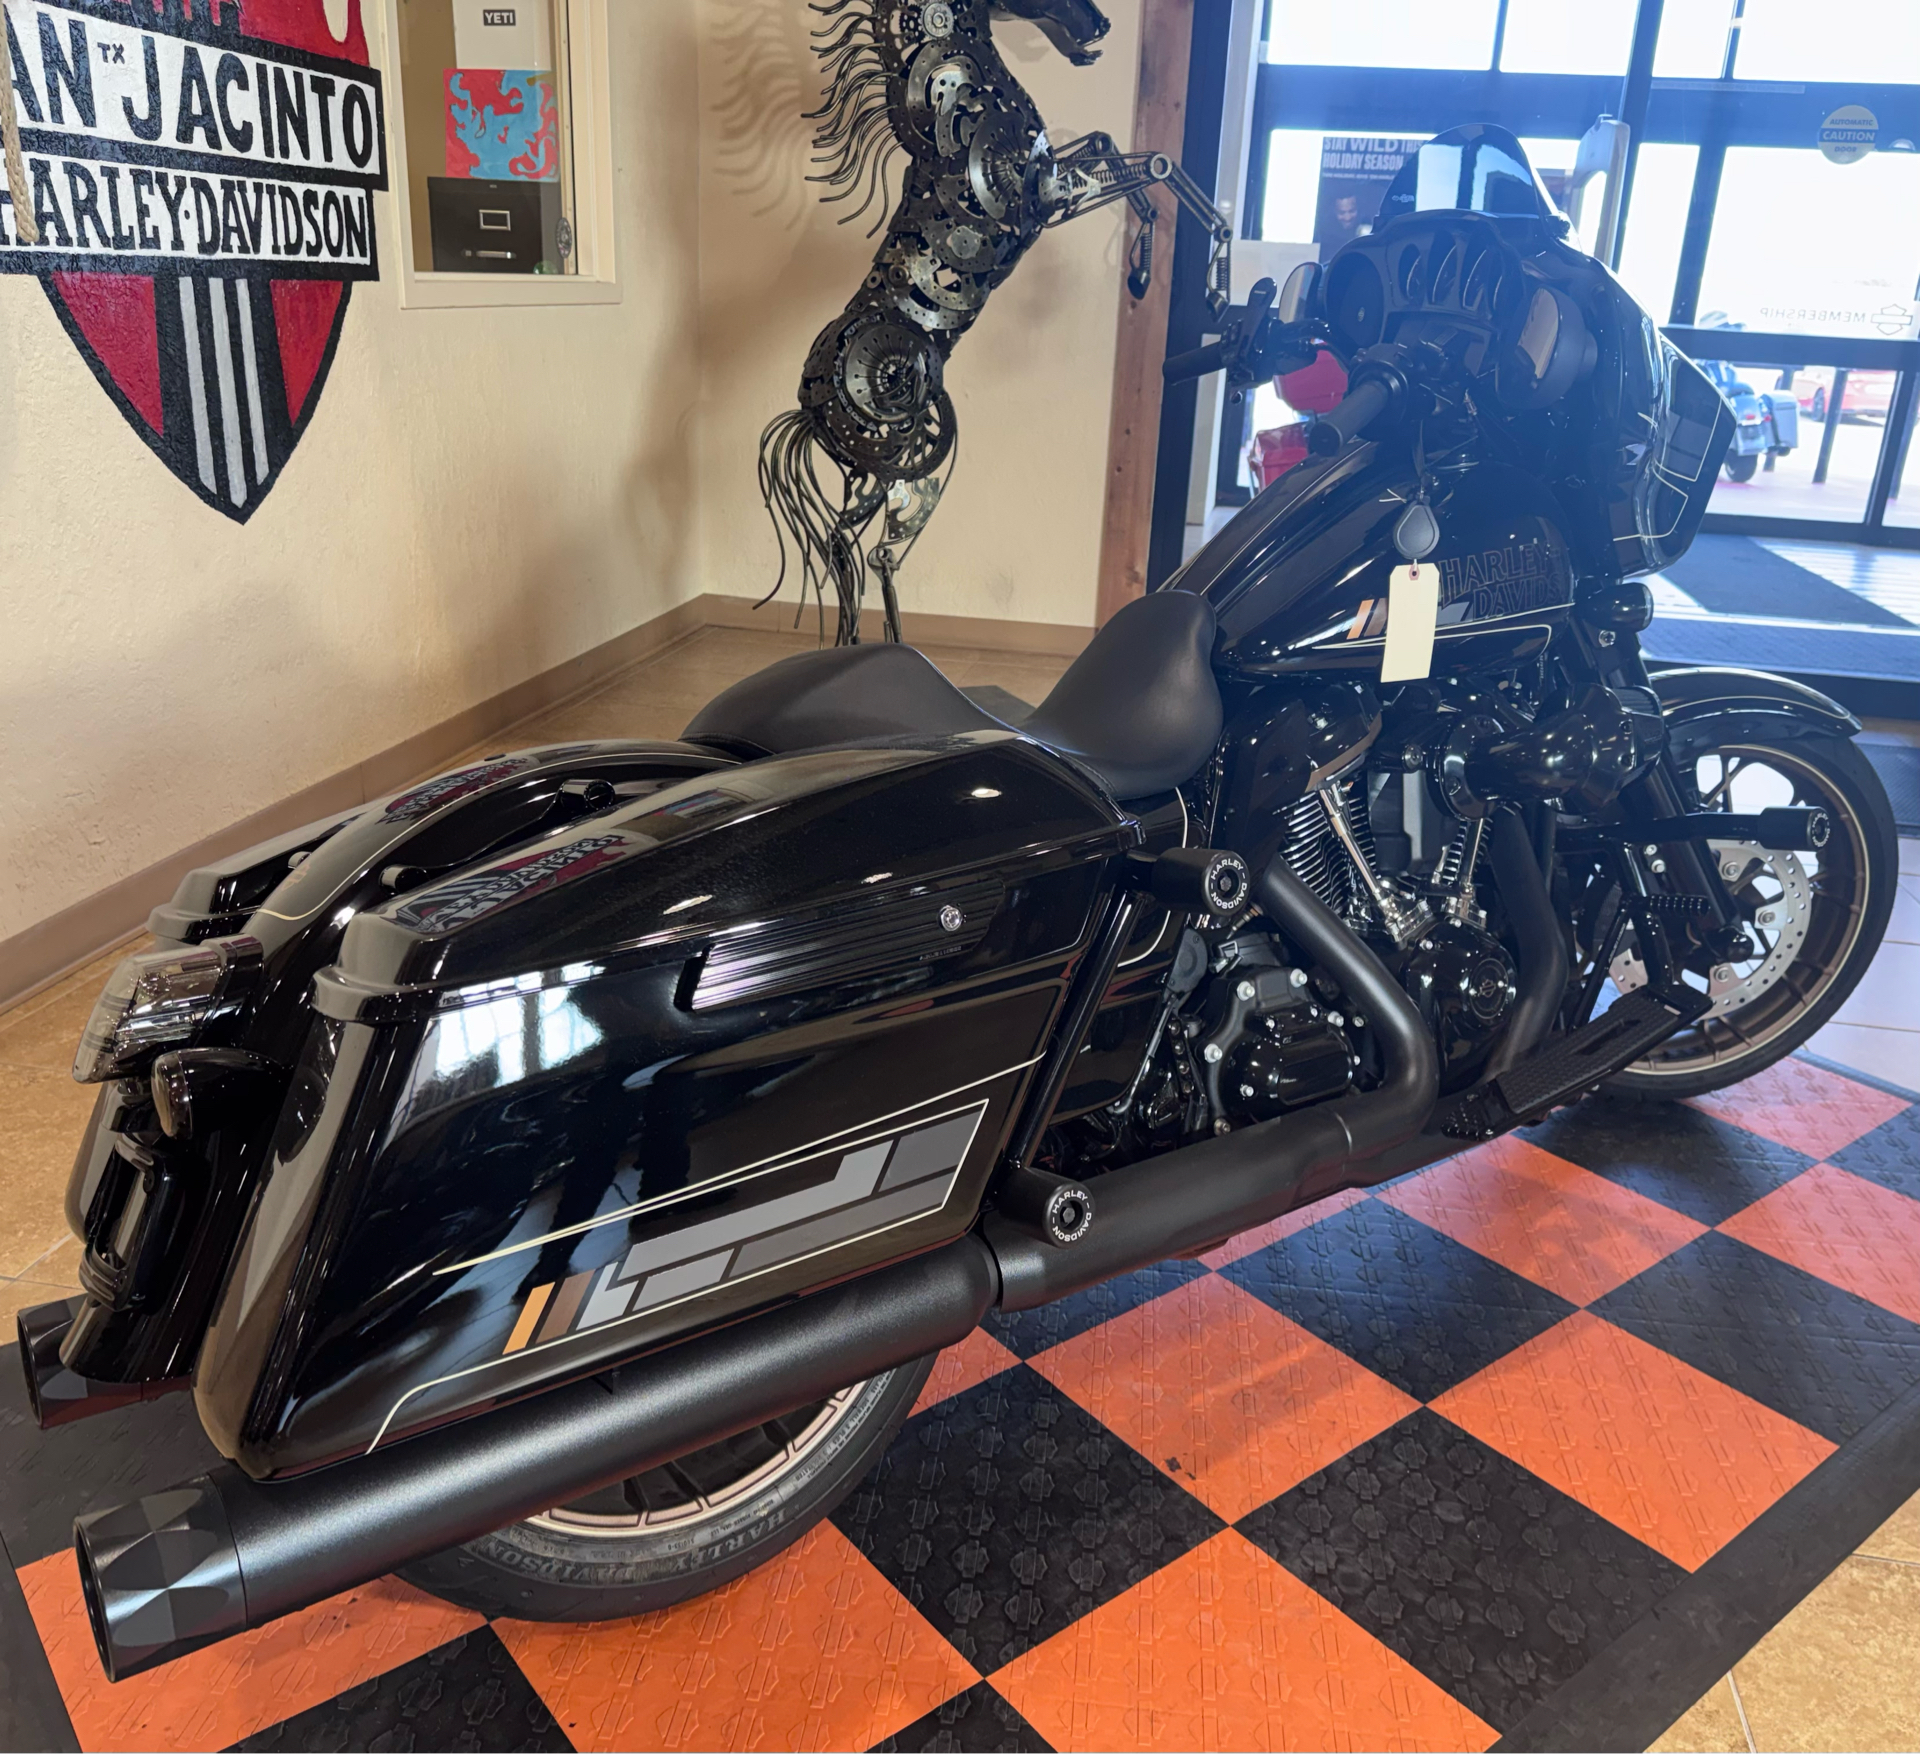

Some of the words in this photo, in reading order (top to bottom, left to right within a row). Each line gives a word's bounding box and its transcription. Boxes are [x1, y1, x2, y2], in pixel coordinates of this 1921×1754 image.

[484, 11, 514, 24] YETI
[98, 42, 125, 64] TX
[122, 36, 374, 168] JACINTO
[1829, 118, 1874, 126] AUTOMATIC
[1349, 137, 1399, 153] WILD
[1822, 131, 1876, 141] CAUTION
[1322, 152, 1364, 169] HOLIDAY
[1364, 154, 1404, 171] SEASON
[1211, 858, 1243, 880] HARLEY
[1211, 882, 1248, 909] DAVIDSON
[1052, 1190, 1088, 1214] HARLEY
[1052, 1212, 1092, 1242] DAVIDSON
[671, 1508, 788, 1573] HARLEY
[484, 1540, 635, 1582] DAVIDSON
